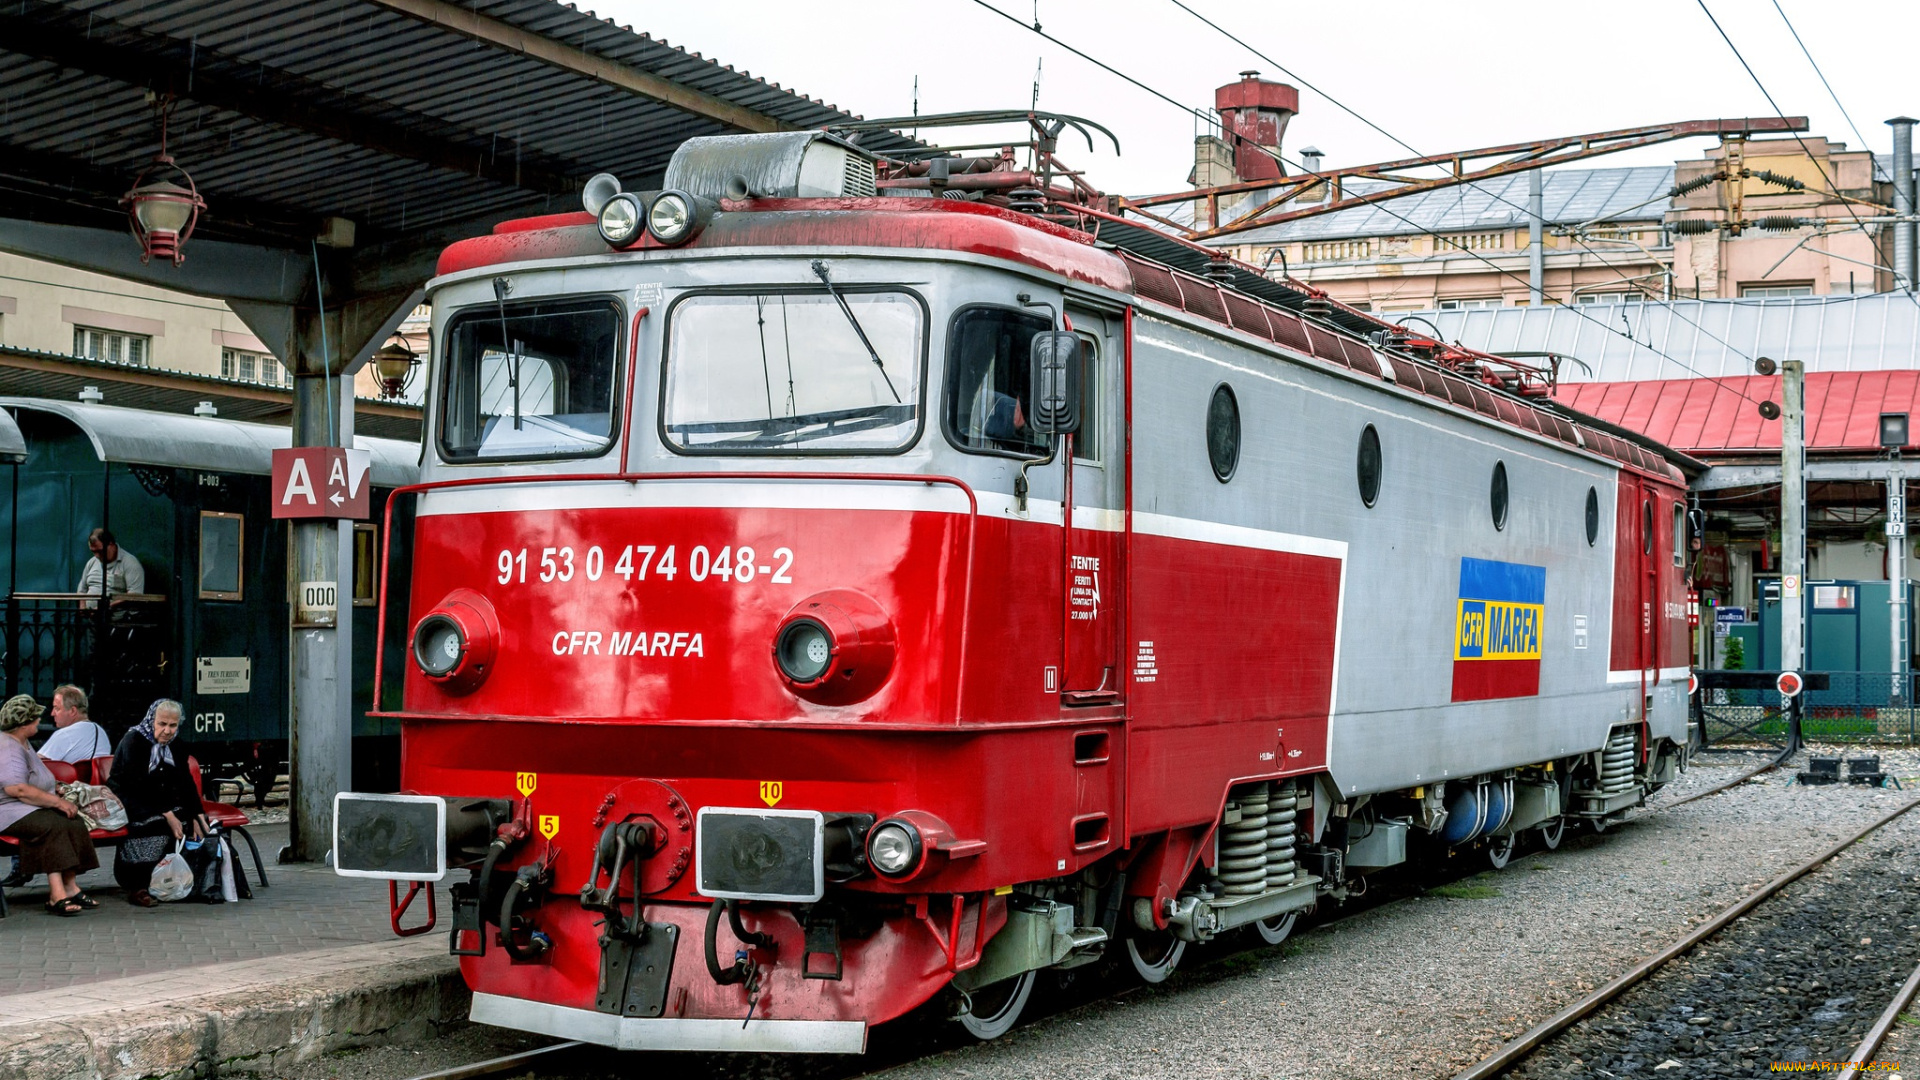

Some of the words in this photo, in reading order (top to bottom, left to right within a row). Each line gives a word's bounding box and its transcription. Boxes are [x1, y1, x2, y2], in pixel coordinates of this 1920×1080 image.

[635, 282, 663, 290] ATENTIE
[328, 457, 346, 487] A
[281, 458, 317, 505] A
[1891, 523, 1902, 535] 12
[497, 548, 528, 585] 91
[539, 546, 575, 582] 53
[585, 545, 604, 581] 0
[614, 545, 677, 581] 474
[689, 545, 794, 584] 048-2
[1070, 555, 1100, 571] TENTIE
[1074, 575, 1092, 586] FERITI
[305, 587, 335, 606] 000
[1072, 597, 1093, 606] CONTACT
[1071, 611, 1088, 620] 27.000
[1088, 611, 1093, 620] V
[1462, 611, 1483, 647] CFR
[1488, 606, 1538, 653] MARFA
[551, 630, 603, 656] CFR
[607, 631, 704, 657] MARFA
[194, 712, 225, 732] CFR
[518, 774, 535, 789] 10
[761, 782, 780, 799] 10
[544, 817, 553, 834] 5
